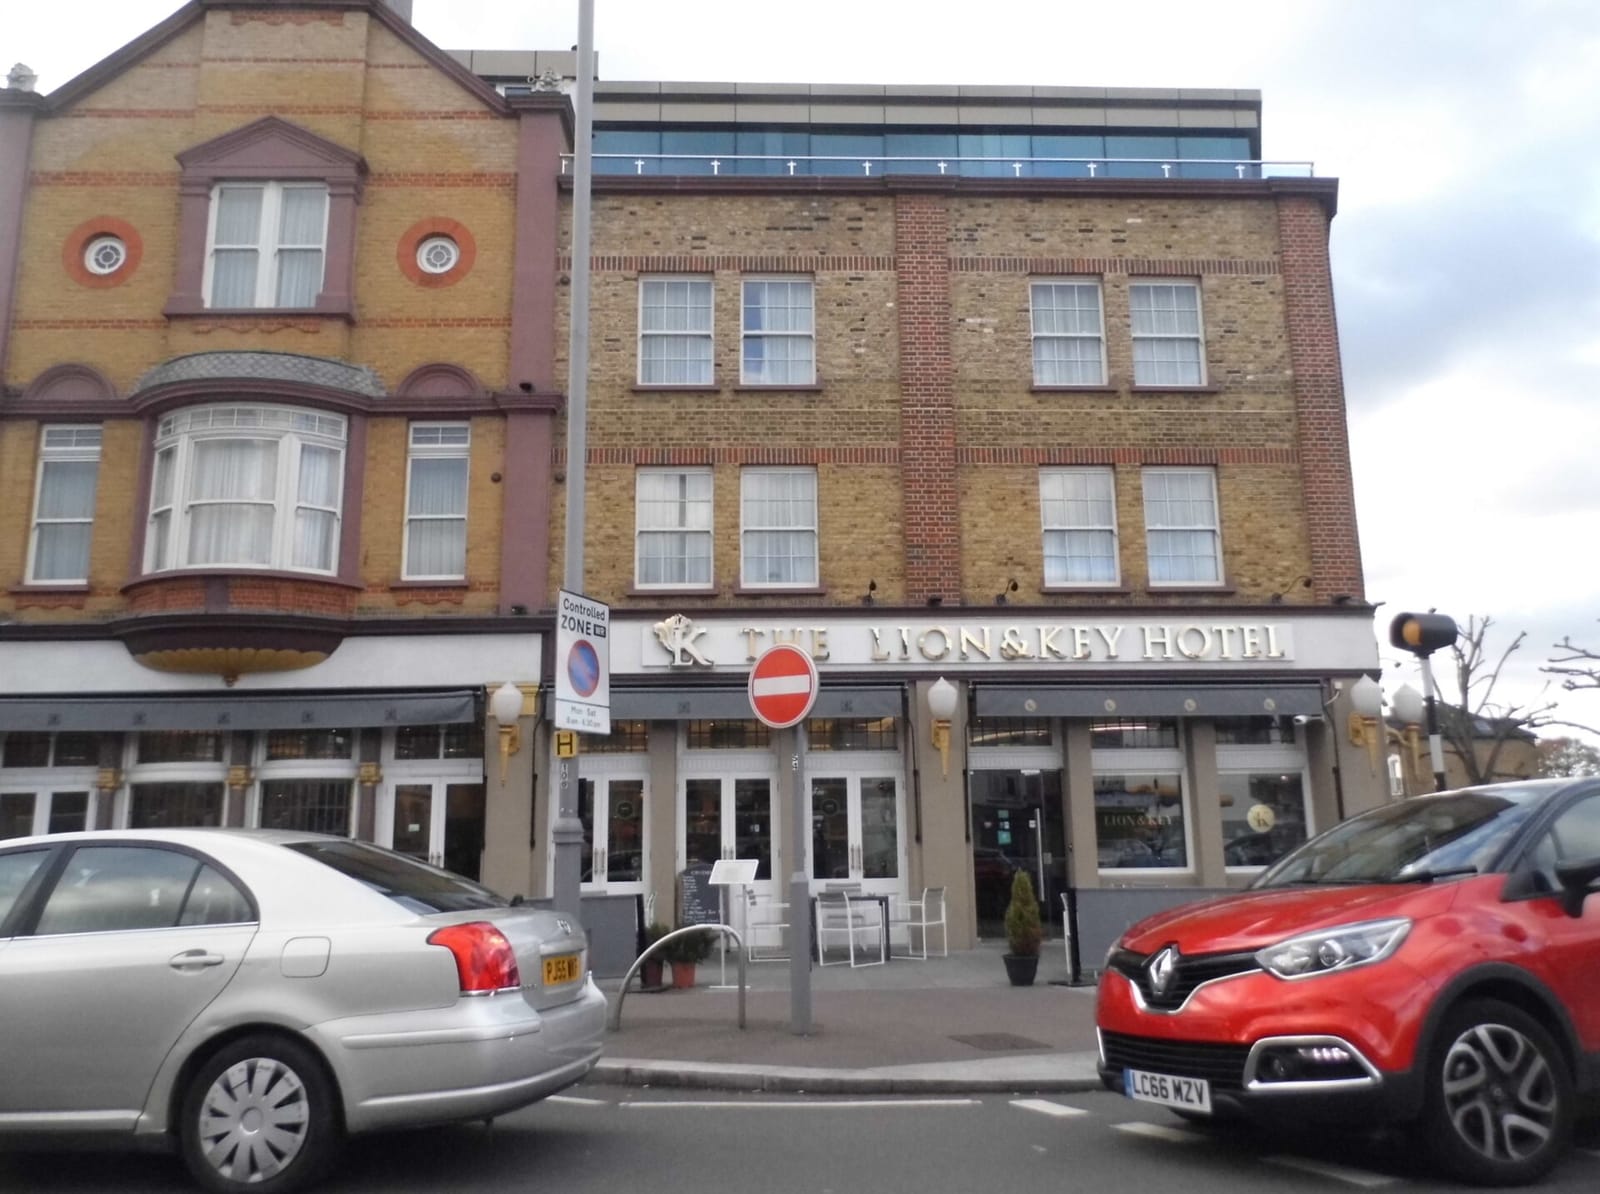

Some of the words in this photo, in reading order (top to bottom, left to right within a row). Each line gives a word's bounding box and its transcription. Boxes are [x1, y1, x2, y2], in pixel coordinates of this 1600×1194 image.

[563, 598, 606, 621] Controlled
[561, 614, 592, 636] ZONE
[740, 627, 830, 661] THE
[869, 625, 1125, 661] LION&KEY
[1141, 624, 1285, 660] HOTEL
[557, 732, 573, 756] H
[1131, 1071, 1169, 1100] LC66
[1171, 1079, 1204, 1105] MZV
